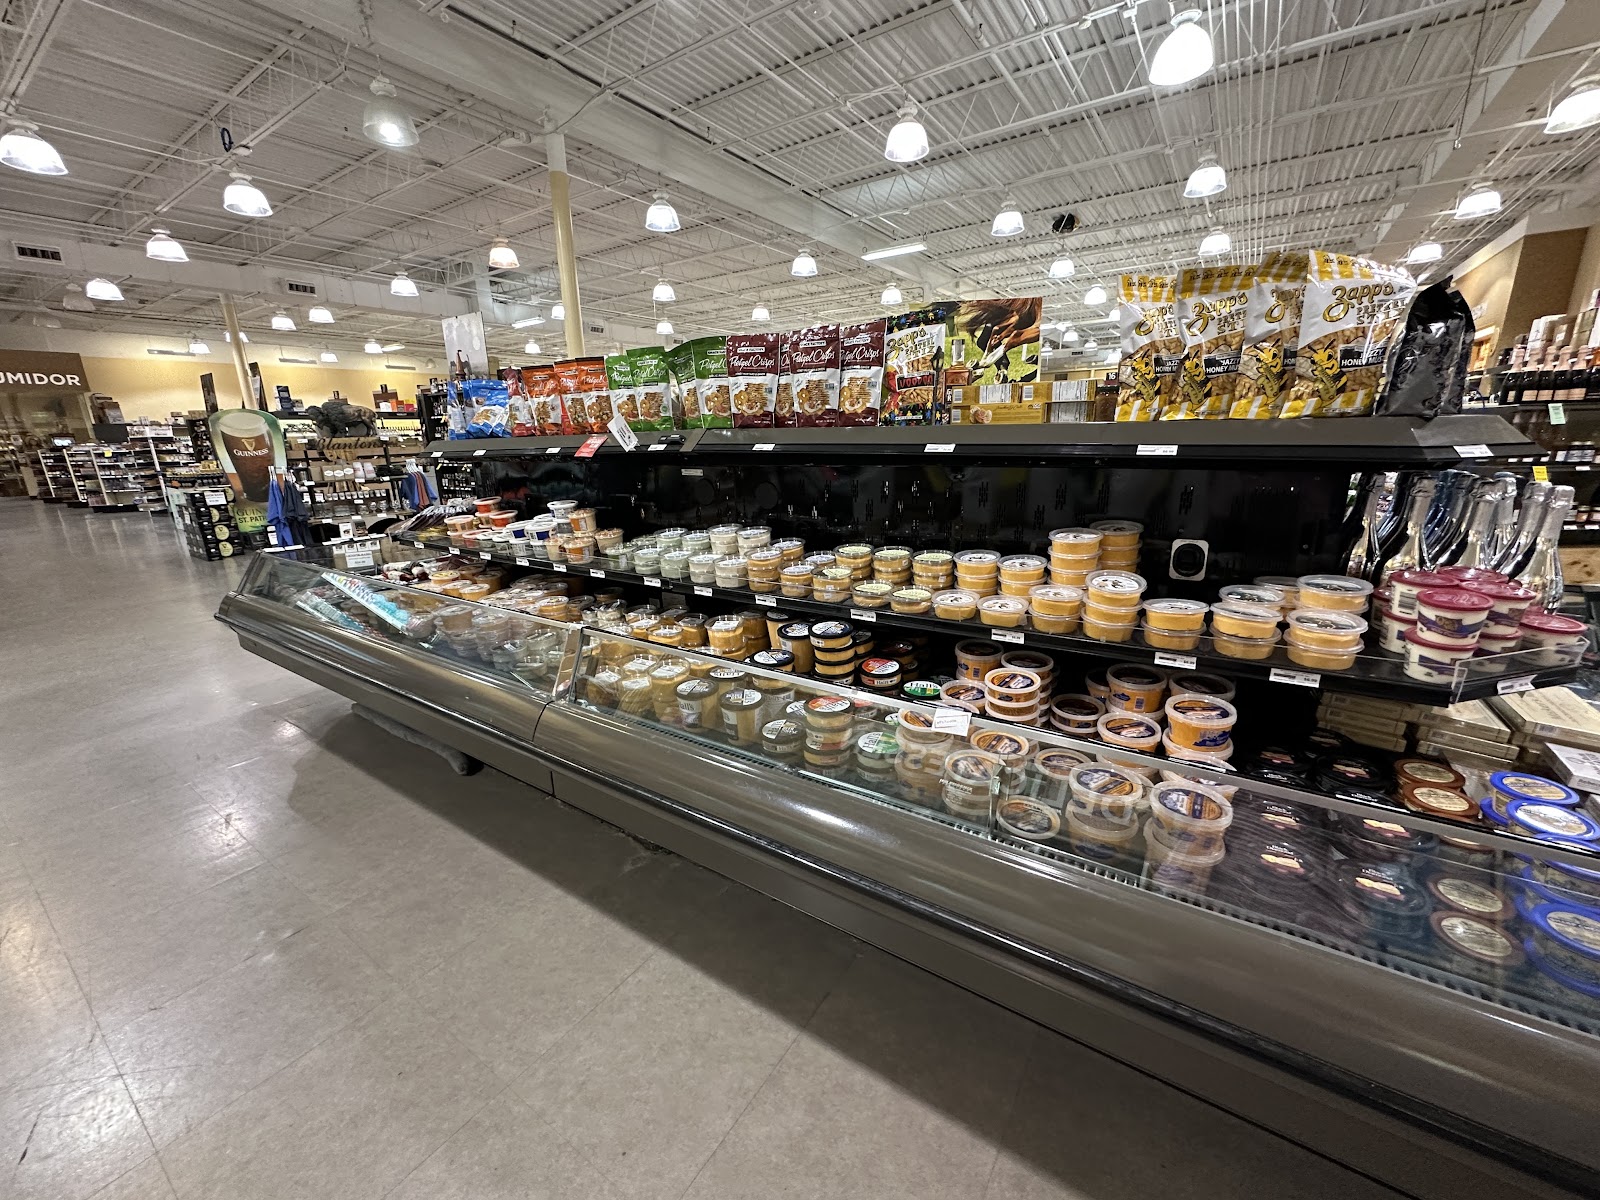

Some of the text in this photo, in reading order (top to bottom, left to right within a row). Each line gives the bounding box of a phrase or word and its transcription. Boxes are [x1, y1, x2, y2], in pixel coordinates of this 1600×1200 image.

[1360, 348, 1384, 359] JZZY
[752, 354, 775, 368] Crisps
[1206, 364, 1228, 374] HONEY
[233, 448, 269, 457] GUINNESS
[236, 508, 267, 517] GUIN
